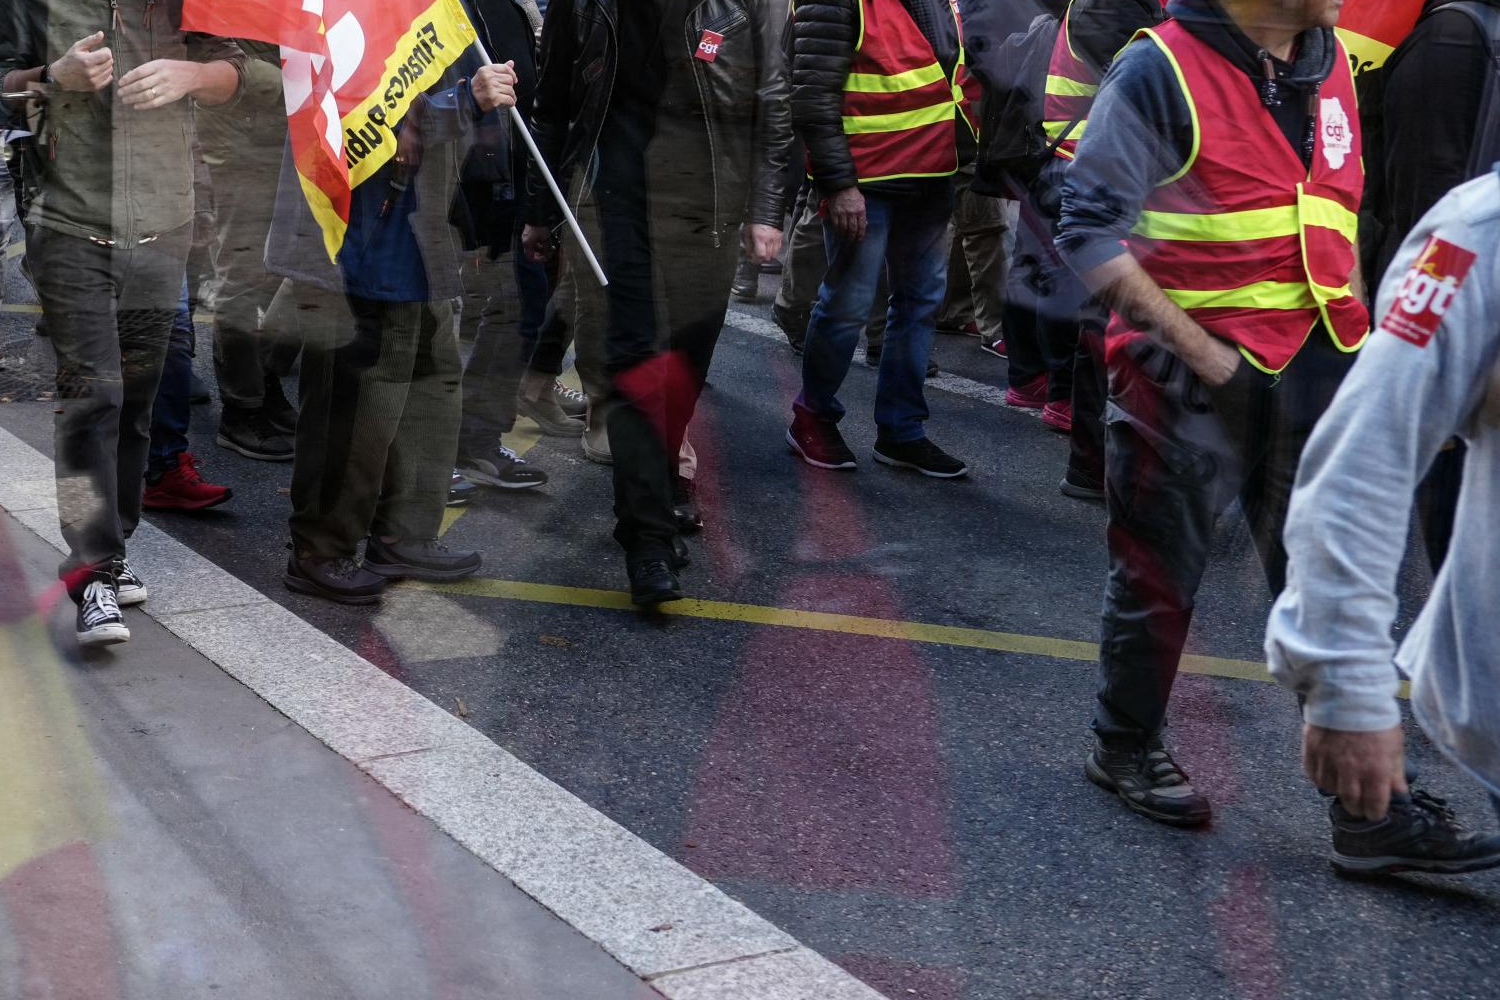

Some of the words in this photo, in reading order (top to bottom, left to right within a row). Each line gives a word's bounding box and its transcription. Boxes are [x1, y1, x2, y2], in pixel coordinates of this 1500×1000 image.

[699, 42, 718, 54] cgt
[1326, 125, 1345, 141] cgt
[1396, 268, 1457, 315] cgt
